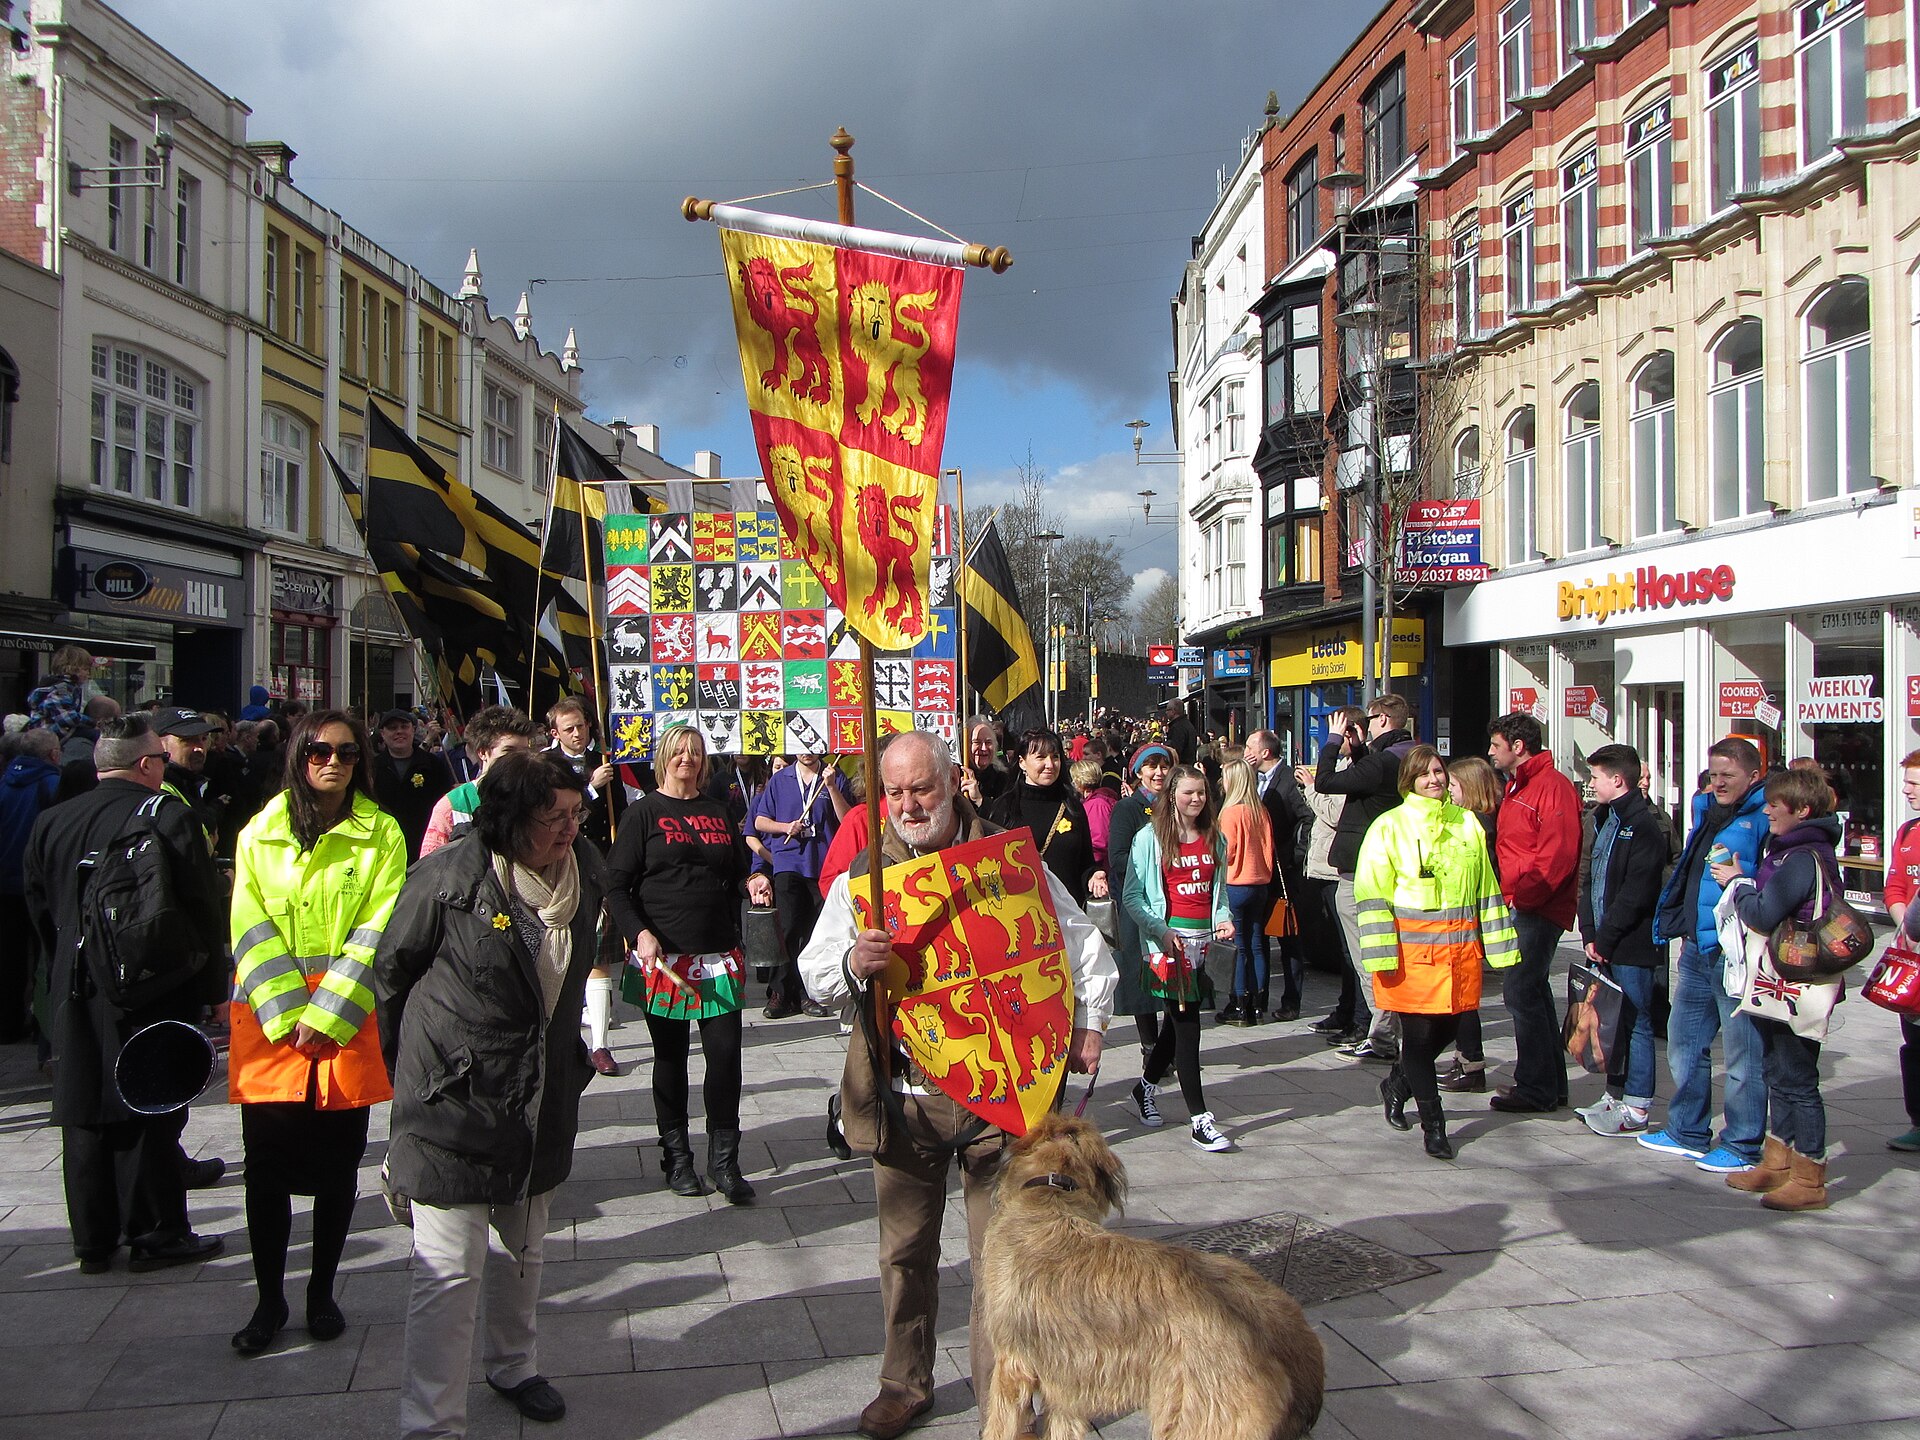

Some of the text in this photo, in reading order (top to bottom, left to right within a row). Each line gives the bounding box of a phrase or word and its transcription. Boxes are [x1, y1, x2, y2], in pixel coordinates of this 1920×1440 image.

[1421, 507, 1468, 518] TO LET
[1406, 530, 1474, 546] Fletcher
[1407, 551, 1470, 566] Morgan
[1421, 569, 1453, 582] 2037
[1457, 568, 1489, 581] 8921
[106, 579, 134, 593] HILL
[187, 580, 228, 619] HILL
[1557, 565, 1735, 625] BrightHouse
[1392, 632, 1421, 642] eeds
[1312, 631, 1347, 660] Leeds
[1225, 667, 1249, 675] GREGGS
[1312, 662, 1347, 677] Building Society
[1721, 686, 1760, 697] COOKERS
[1809, 679, 1871, 698] WEEKLY
[1512, 691, 1524, 702] TVs
[1731, 701, 1742, 715] £3
[1799, 701, 1882, 720] PAYMENTS
[658, 815, 727, 832] CYMRU
[1191, 869, 1201, 881] A
[1176, 882, 1211, 895] CWTCH
[1846, 890, 1871, 902] EXTRAS
